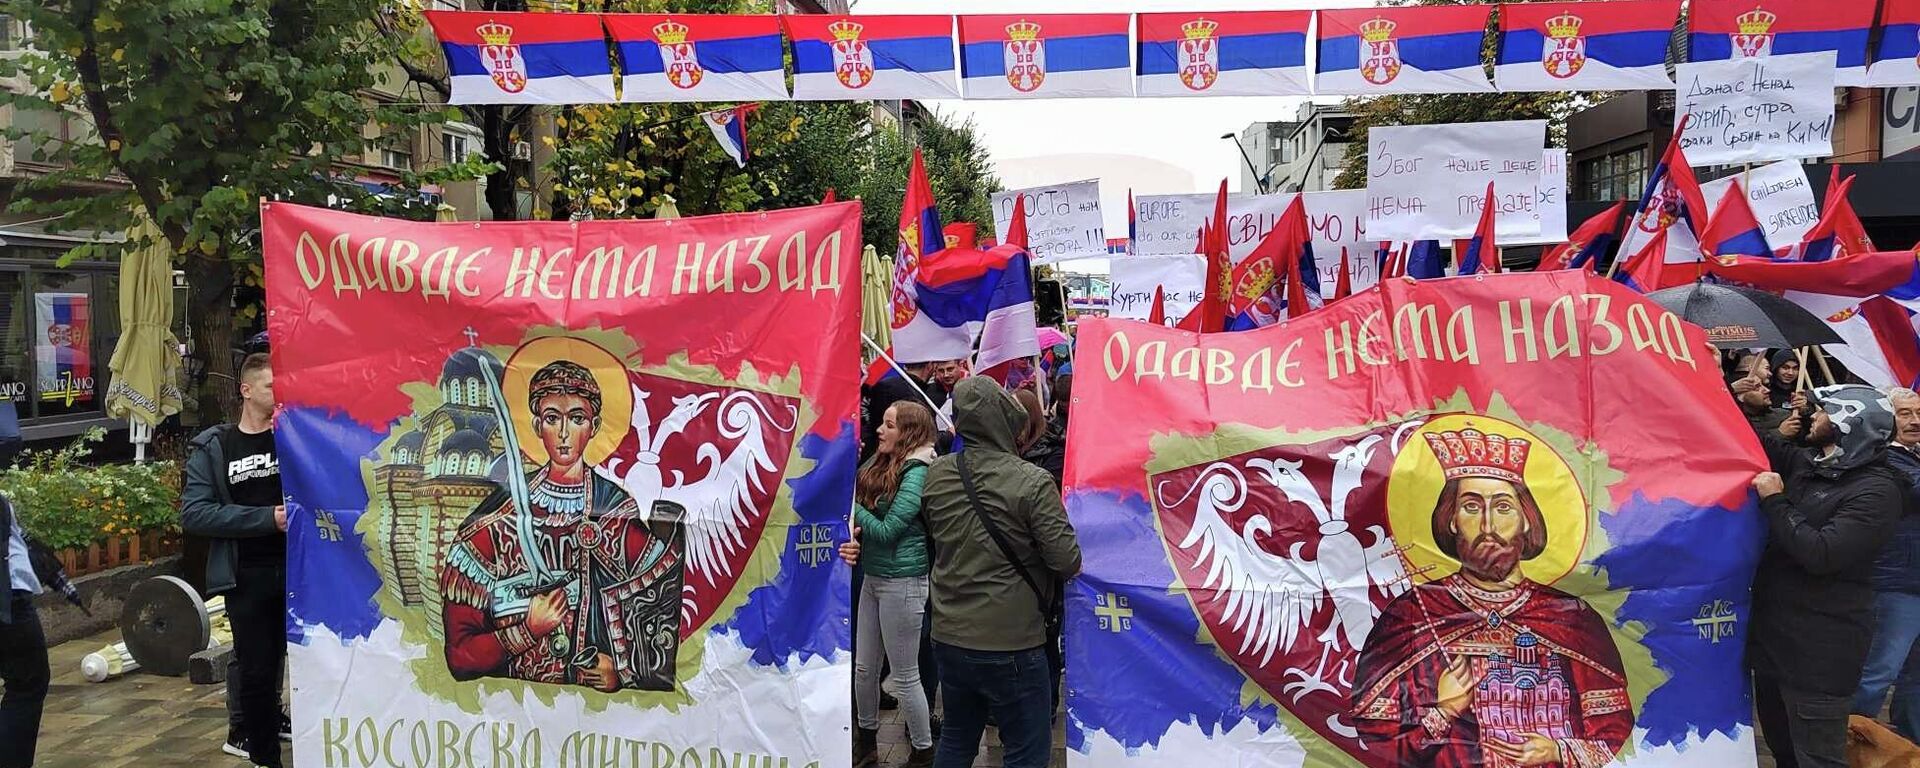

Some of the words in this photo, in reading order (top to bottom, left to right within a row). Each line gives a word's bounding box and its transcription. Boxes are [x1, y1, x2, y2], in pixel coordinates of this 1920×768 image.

[1751, 63, 1794, 93] Ненад
[503, 244, 657, 300] НЕМА
[671, 230, 841, 300] НАЗАД
[1324, 301, 1480, 380] НЕМА
[1499, 294, 1697, 372] НАЗАД
[228, 453, 278, 476] REPL
